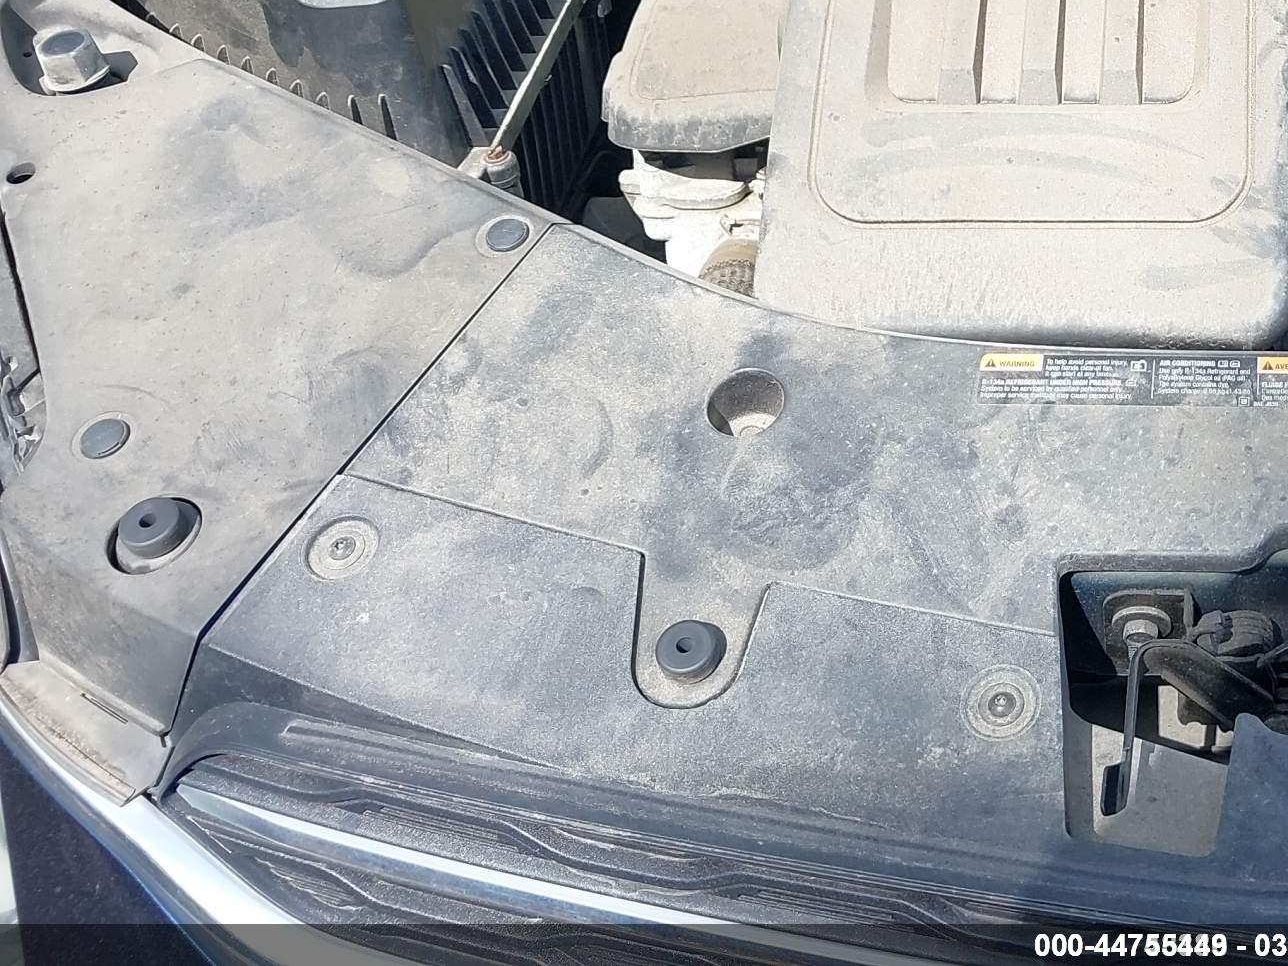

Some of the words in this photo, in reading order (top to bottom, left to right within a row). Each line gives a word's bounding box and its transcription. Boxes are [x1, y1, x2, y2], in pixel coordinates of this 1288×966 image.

[999, 360, 1035, 368] WARNING
[1085, 359, 1110, 367] personal
[1070, 392, 1088, 400] cause
